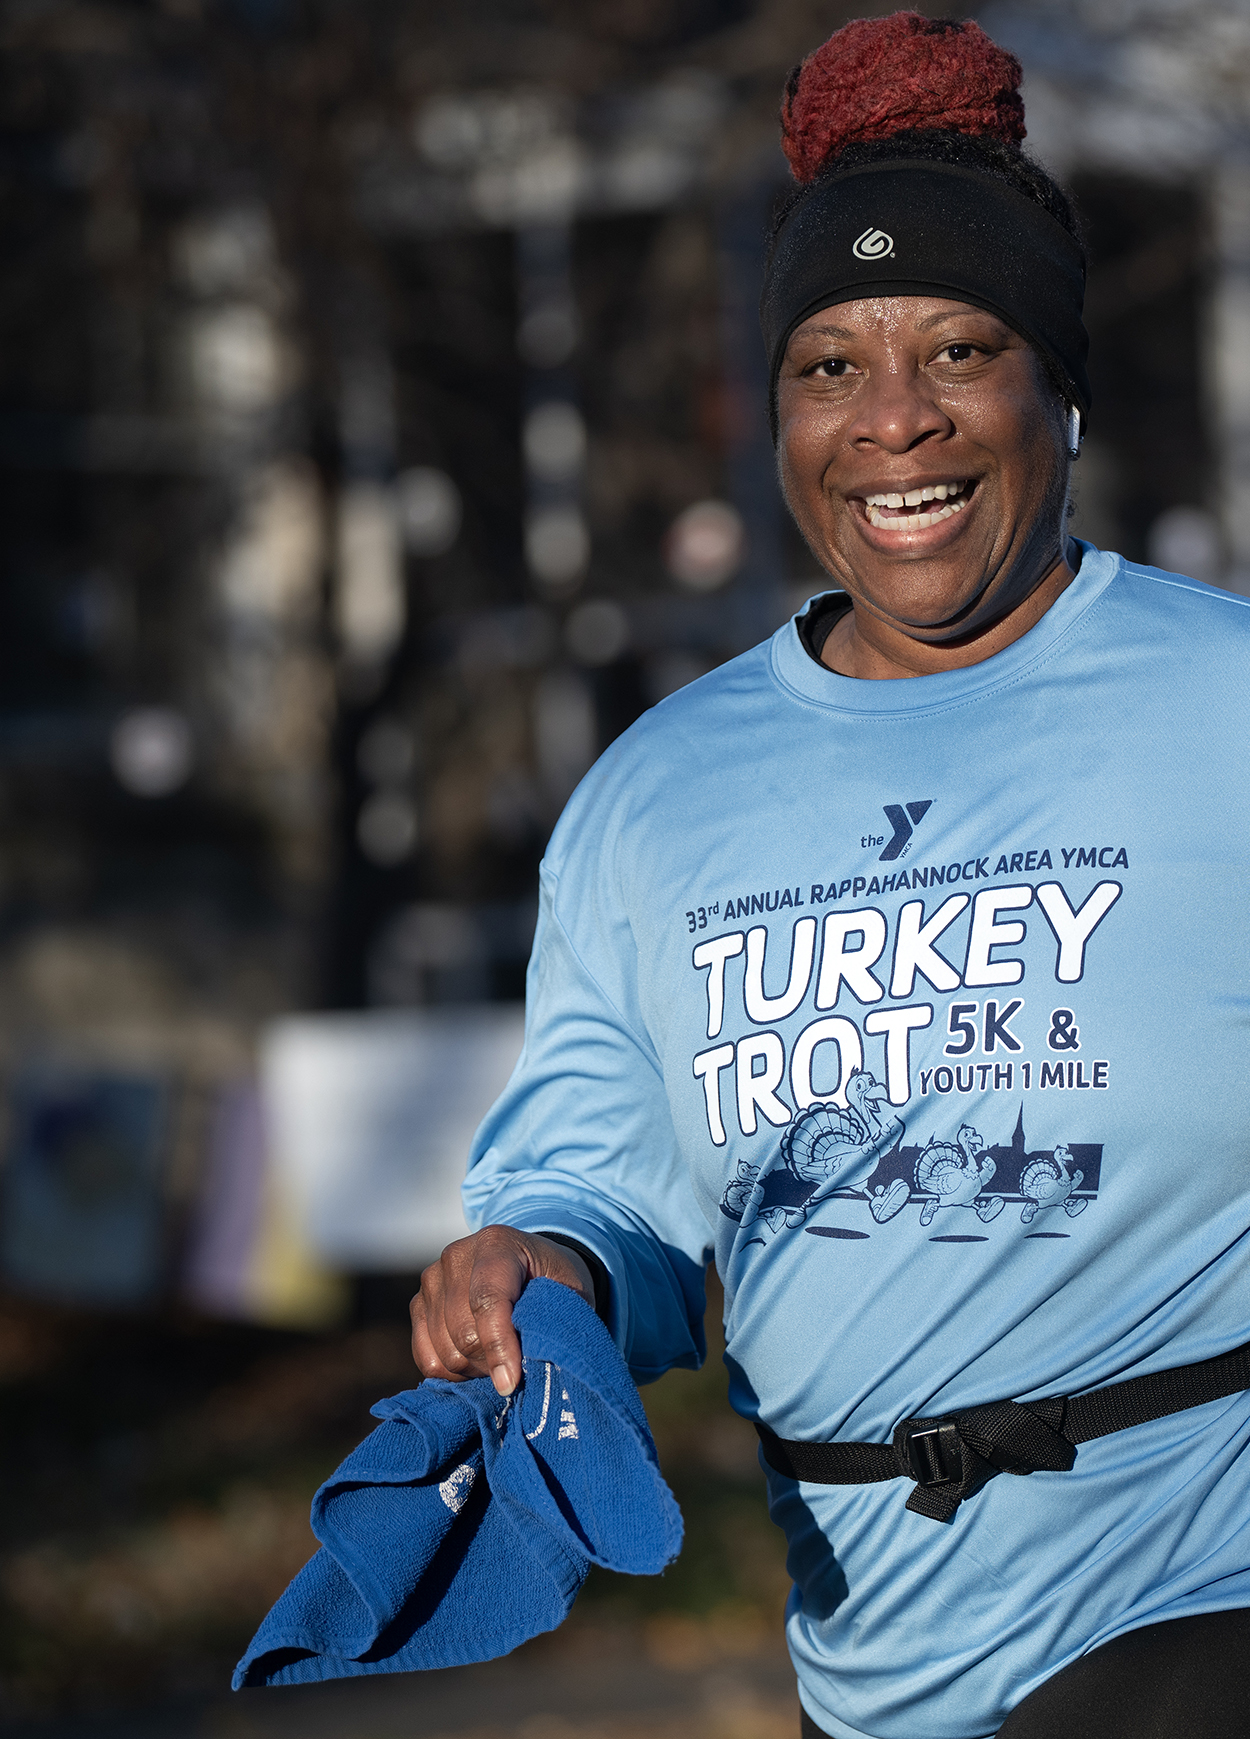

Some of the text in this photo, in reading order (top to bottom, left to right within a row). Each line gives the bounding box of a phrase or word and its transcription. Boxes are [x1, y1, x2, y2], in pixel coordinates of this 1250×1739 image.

[861, 834, 884, 848] the
[900, 842, 913, 859] YMCA
[685, 846, 1129, 933] 33rd ANNUAL RAPPAHANNOCK AREA YMCA
[692, 880, 1123, 1040] TURKEY
[943, 998, 1081, 1055] 5K &
[692, 1003, 933, 1148] TROT
[919, 1060, 1110, 1096] YOUTH 1 MILE
